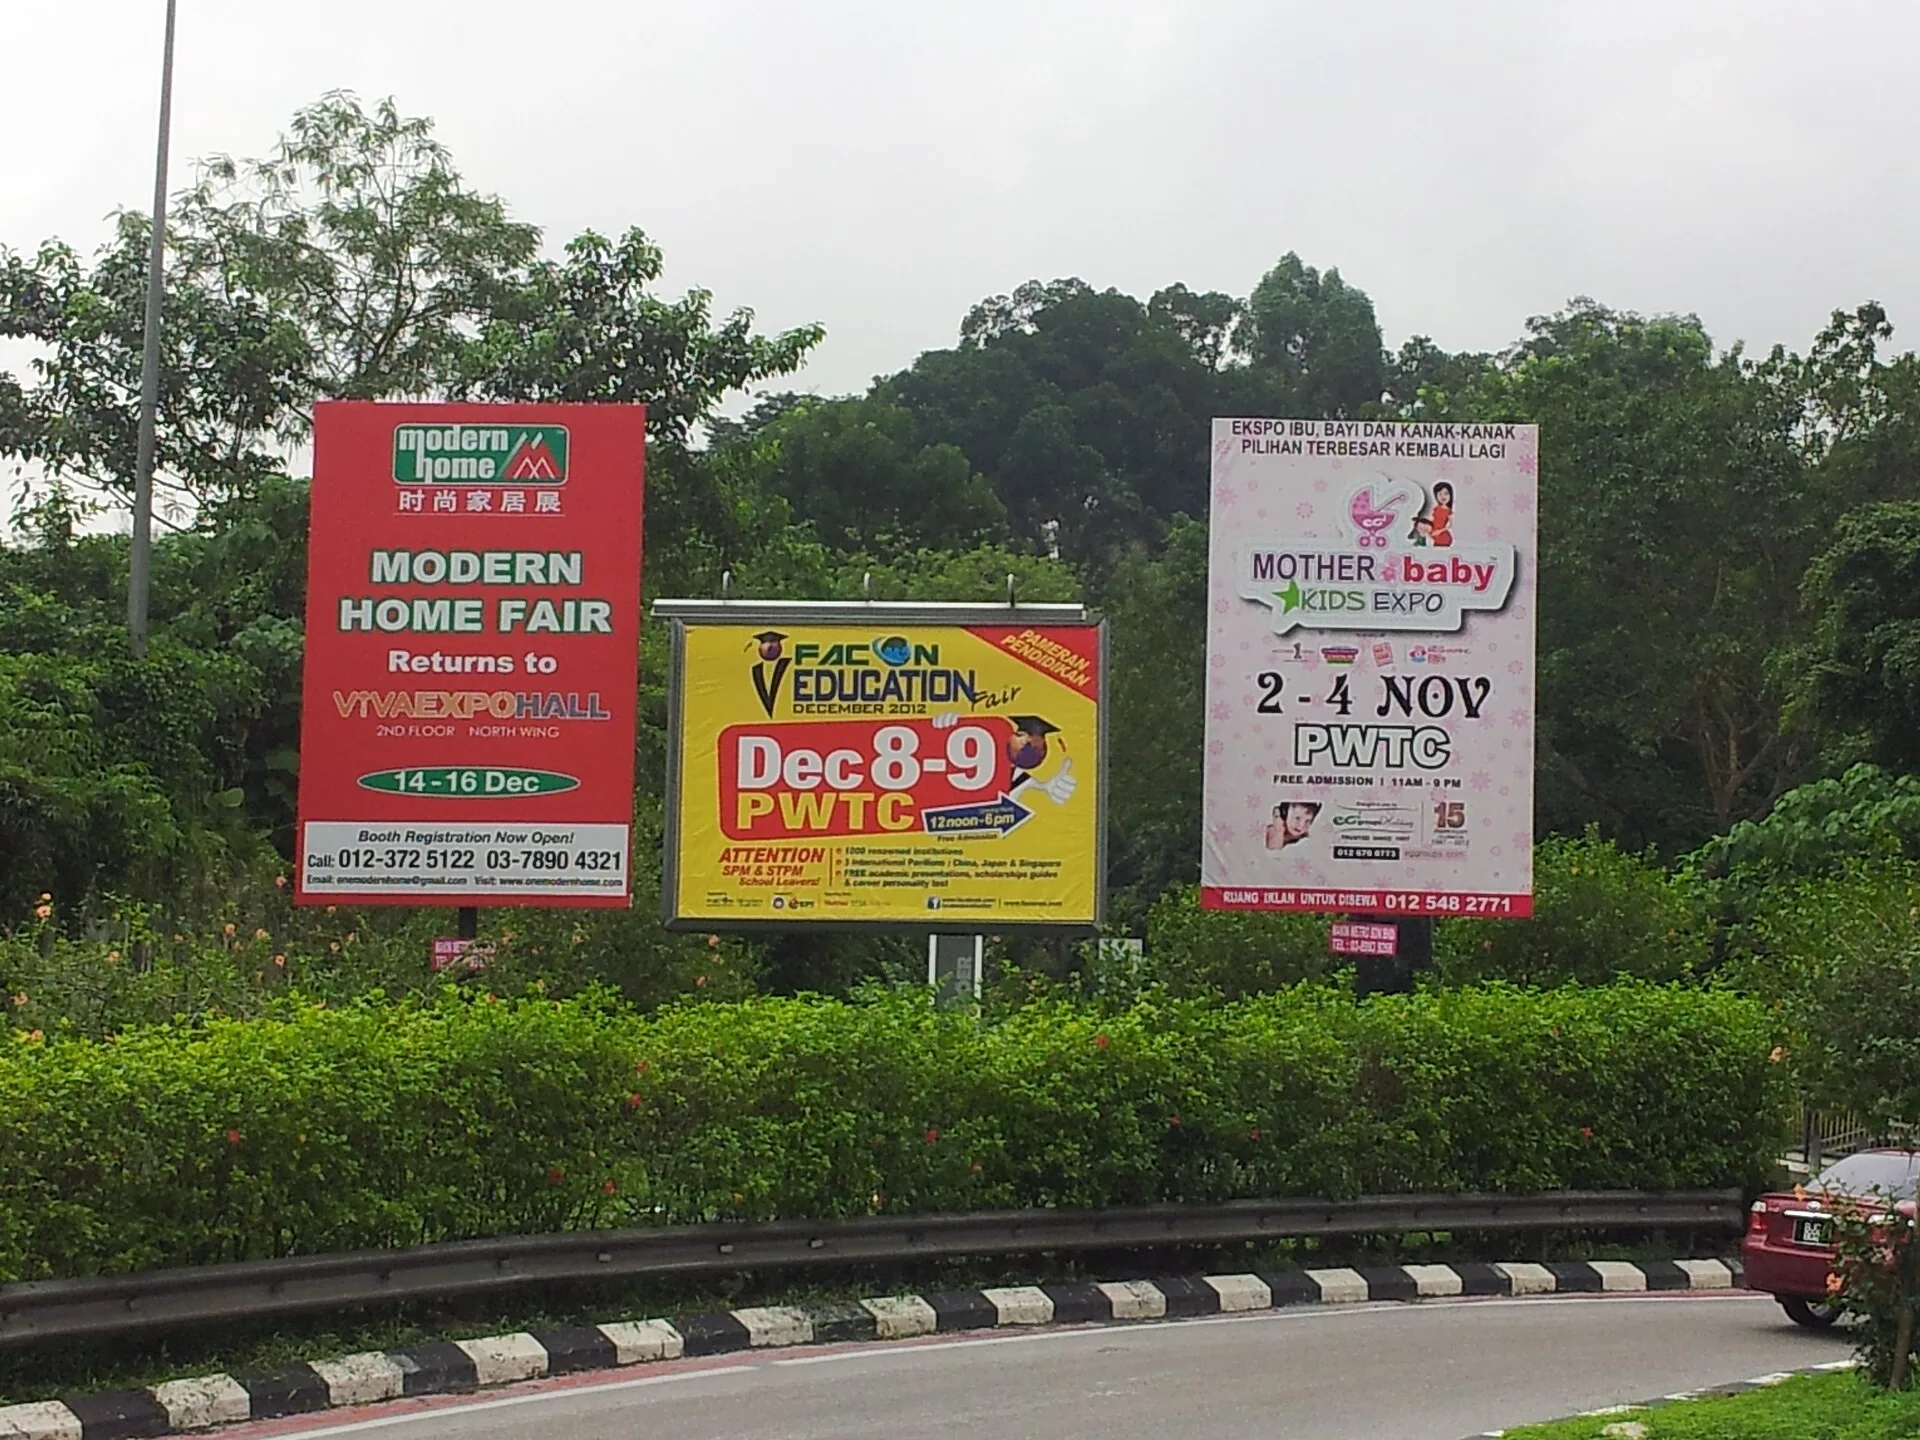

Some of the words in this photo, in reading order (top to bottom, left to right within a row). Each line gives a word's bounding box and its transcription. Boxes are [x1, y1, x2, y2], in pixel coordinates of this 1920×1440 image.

[399, 425, 509, 453] modern
[1232, 421, 1285, 436] EKSPO
[1290, 422, 1319, 438] IBU,
[1324, 423, 1359, 437] BAYI
[1363, 423, 1395, 437] DAN
[1400, 424, 1515, 439] KANAK-KANAK
[1242, 439, 1302, 454] PILIHAN
[1307, 441, 1390, 456] TERBESAR
[1395, 442, 1464, 458] KEMBALI
[1469, 444, 1505, 458] LAGI
[416, 452, 496, 483] home
[399, 490, 561, 512] 时尚家居展
[372, 552, 582, 584] MODERN
[1253, 554, 1375, 581] MOTHER
[1403, 556, 1494, 591] baby
[1301, 590, 1365, 611] KIDS
[1374, 592, 1443, 612] EXPO
[340, 599, 484, 632] HOME
[499, 600, 612, 633] FAIR
[1000, 634, 1091, 687] PENDIDIKAN
[1020, 629, 1090, 671] PAMERAN
[388, 650, 514, 674] Returns
[524, 652, 557, 674] to
[794, 669, 975, 704] EDUCATION
[971, 687, 1022, 711] Fair
[1258, 672, 1283, 714] 2
[1326, 673, 1352, 715] 4
[1377, 675, 1491, 718] NOV
[793, 704, 887, 714] DECEMBER
[889, 704, 926, 714] 2012
[376, 725, 405, 737] 2ND
[408, 725, 455, 738] FLOOR
[469, 726, 516, 738] NORTH
[519, 727, 560, 739] WING
[737, 736, 864, 791] Dec
[871, 725, 998, 791] 8-9
[1294, 724, 1450, 769] PWTC
[485, 772, 539, 792] Dec
[1273, 775, 1303, 784] FREE
[1306, 776, 1373, 786] ADMISSION
[1392, 778, 1423, 787] 11AM
[1433, 778, 1440, 787] 9
[1444, 779, 1461, 788] PM
[737, 791, 915, 831] PWTC
[1434, 802, 1466, 828] 15
[358, 830, 400, 842] Booth
[404, 830, 491, 845] Registration
[494, 831, 528, 843] Now
[531, 832, 575, 846] Open!
[307, 854, 335, 867] Call:
[339, 849, 420, 869] 012-372
[426, 849, 475, 869] 5122
[487, 850, 569, 870] 03-7890
[575, 851, 622, 870] 4321
[718, 848, 826, 863] ATTENTION
[722, 866, 751, 876] SPM
[754, 866, 764, 876] &
[766, 866, 804, 876] STPM
[739, 877, 774, 886] School
[1223, 891, 1259, 904] RUANG
[1300, 892, 1336, 905] UNTUK
[1338, 893, 1377, 906] DISEWA
[1385, 894, 1420, 910] 012
[1425, 896, 1460, 911] 548
[1466, 896, 1510, 912] 2771
